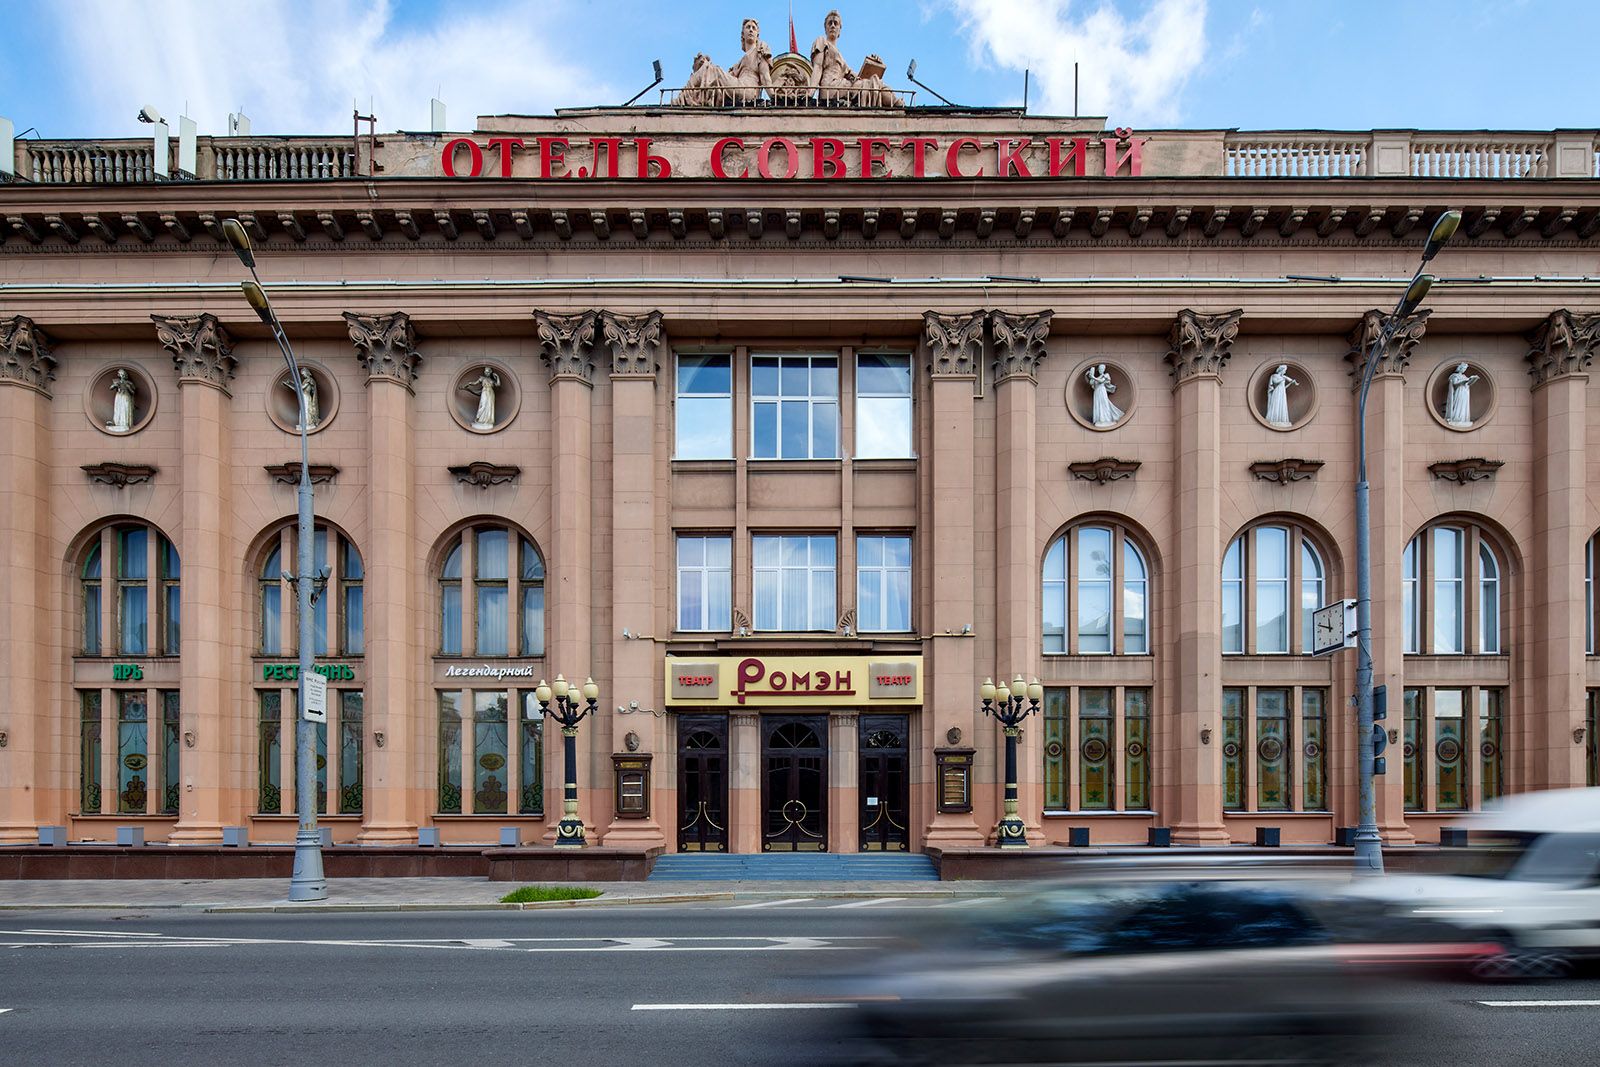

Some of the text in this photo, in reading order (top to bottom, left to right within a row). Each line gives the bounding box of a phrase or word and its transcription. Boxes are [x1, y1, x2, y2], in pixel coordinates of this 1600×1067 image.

[441, 128, 1146, 178] ОТЕЛЬ СОВЕТСКИЙ
[113, 664, 143, 680] ЯРЪ
[263, 664, 354, 680] РЕСТАНЪ
[445, 664, 533, 681] Легендарный
[678, 675, 714, 686] ТЕАТР
[876, 675, 912, 686] ТЕАТР
